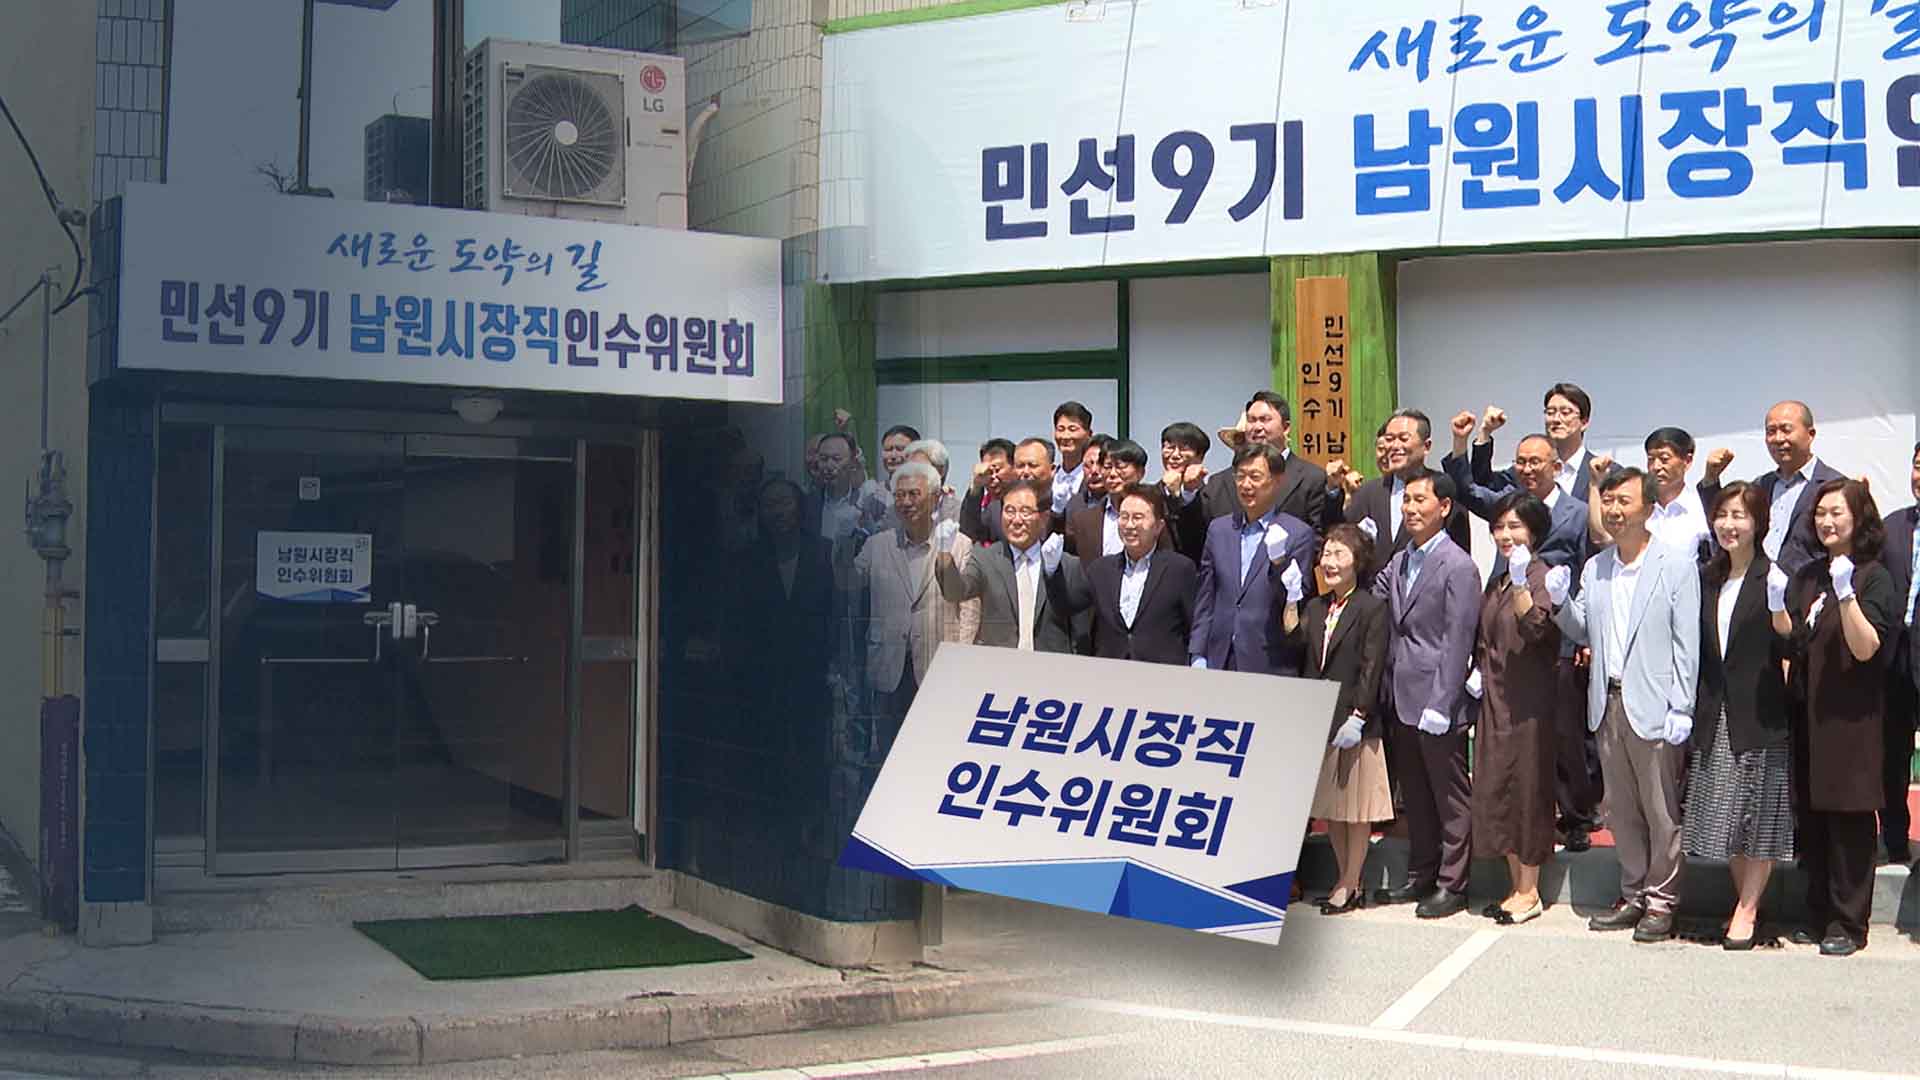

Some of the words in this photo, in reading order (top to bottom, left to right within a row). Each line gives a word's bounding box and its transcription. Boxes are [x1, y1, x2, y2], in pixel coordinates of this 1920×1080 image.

[1349, 4, 1569, 82] 새로운
[1591, 0, 1826, 73] 도약의
[643, 97, 665, 113] LG
[982, 119, 1304, 241] 민선9기
[327, 231, 436, 274] 새로운
[448, 238, 554, 288] 도약의
[566, 239, 609, 291] 길
[159, 279, 330, 351] 민선9기
[1324, 315, 1344, 419] 민선9기
[1326, 431, 1346, 462] 남
[277, 546, 353, 563] 남원시장직
[277, 566, 353, 583] 인수위원회
